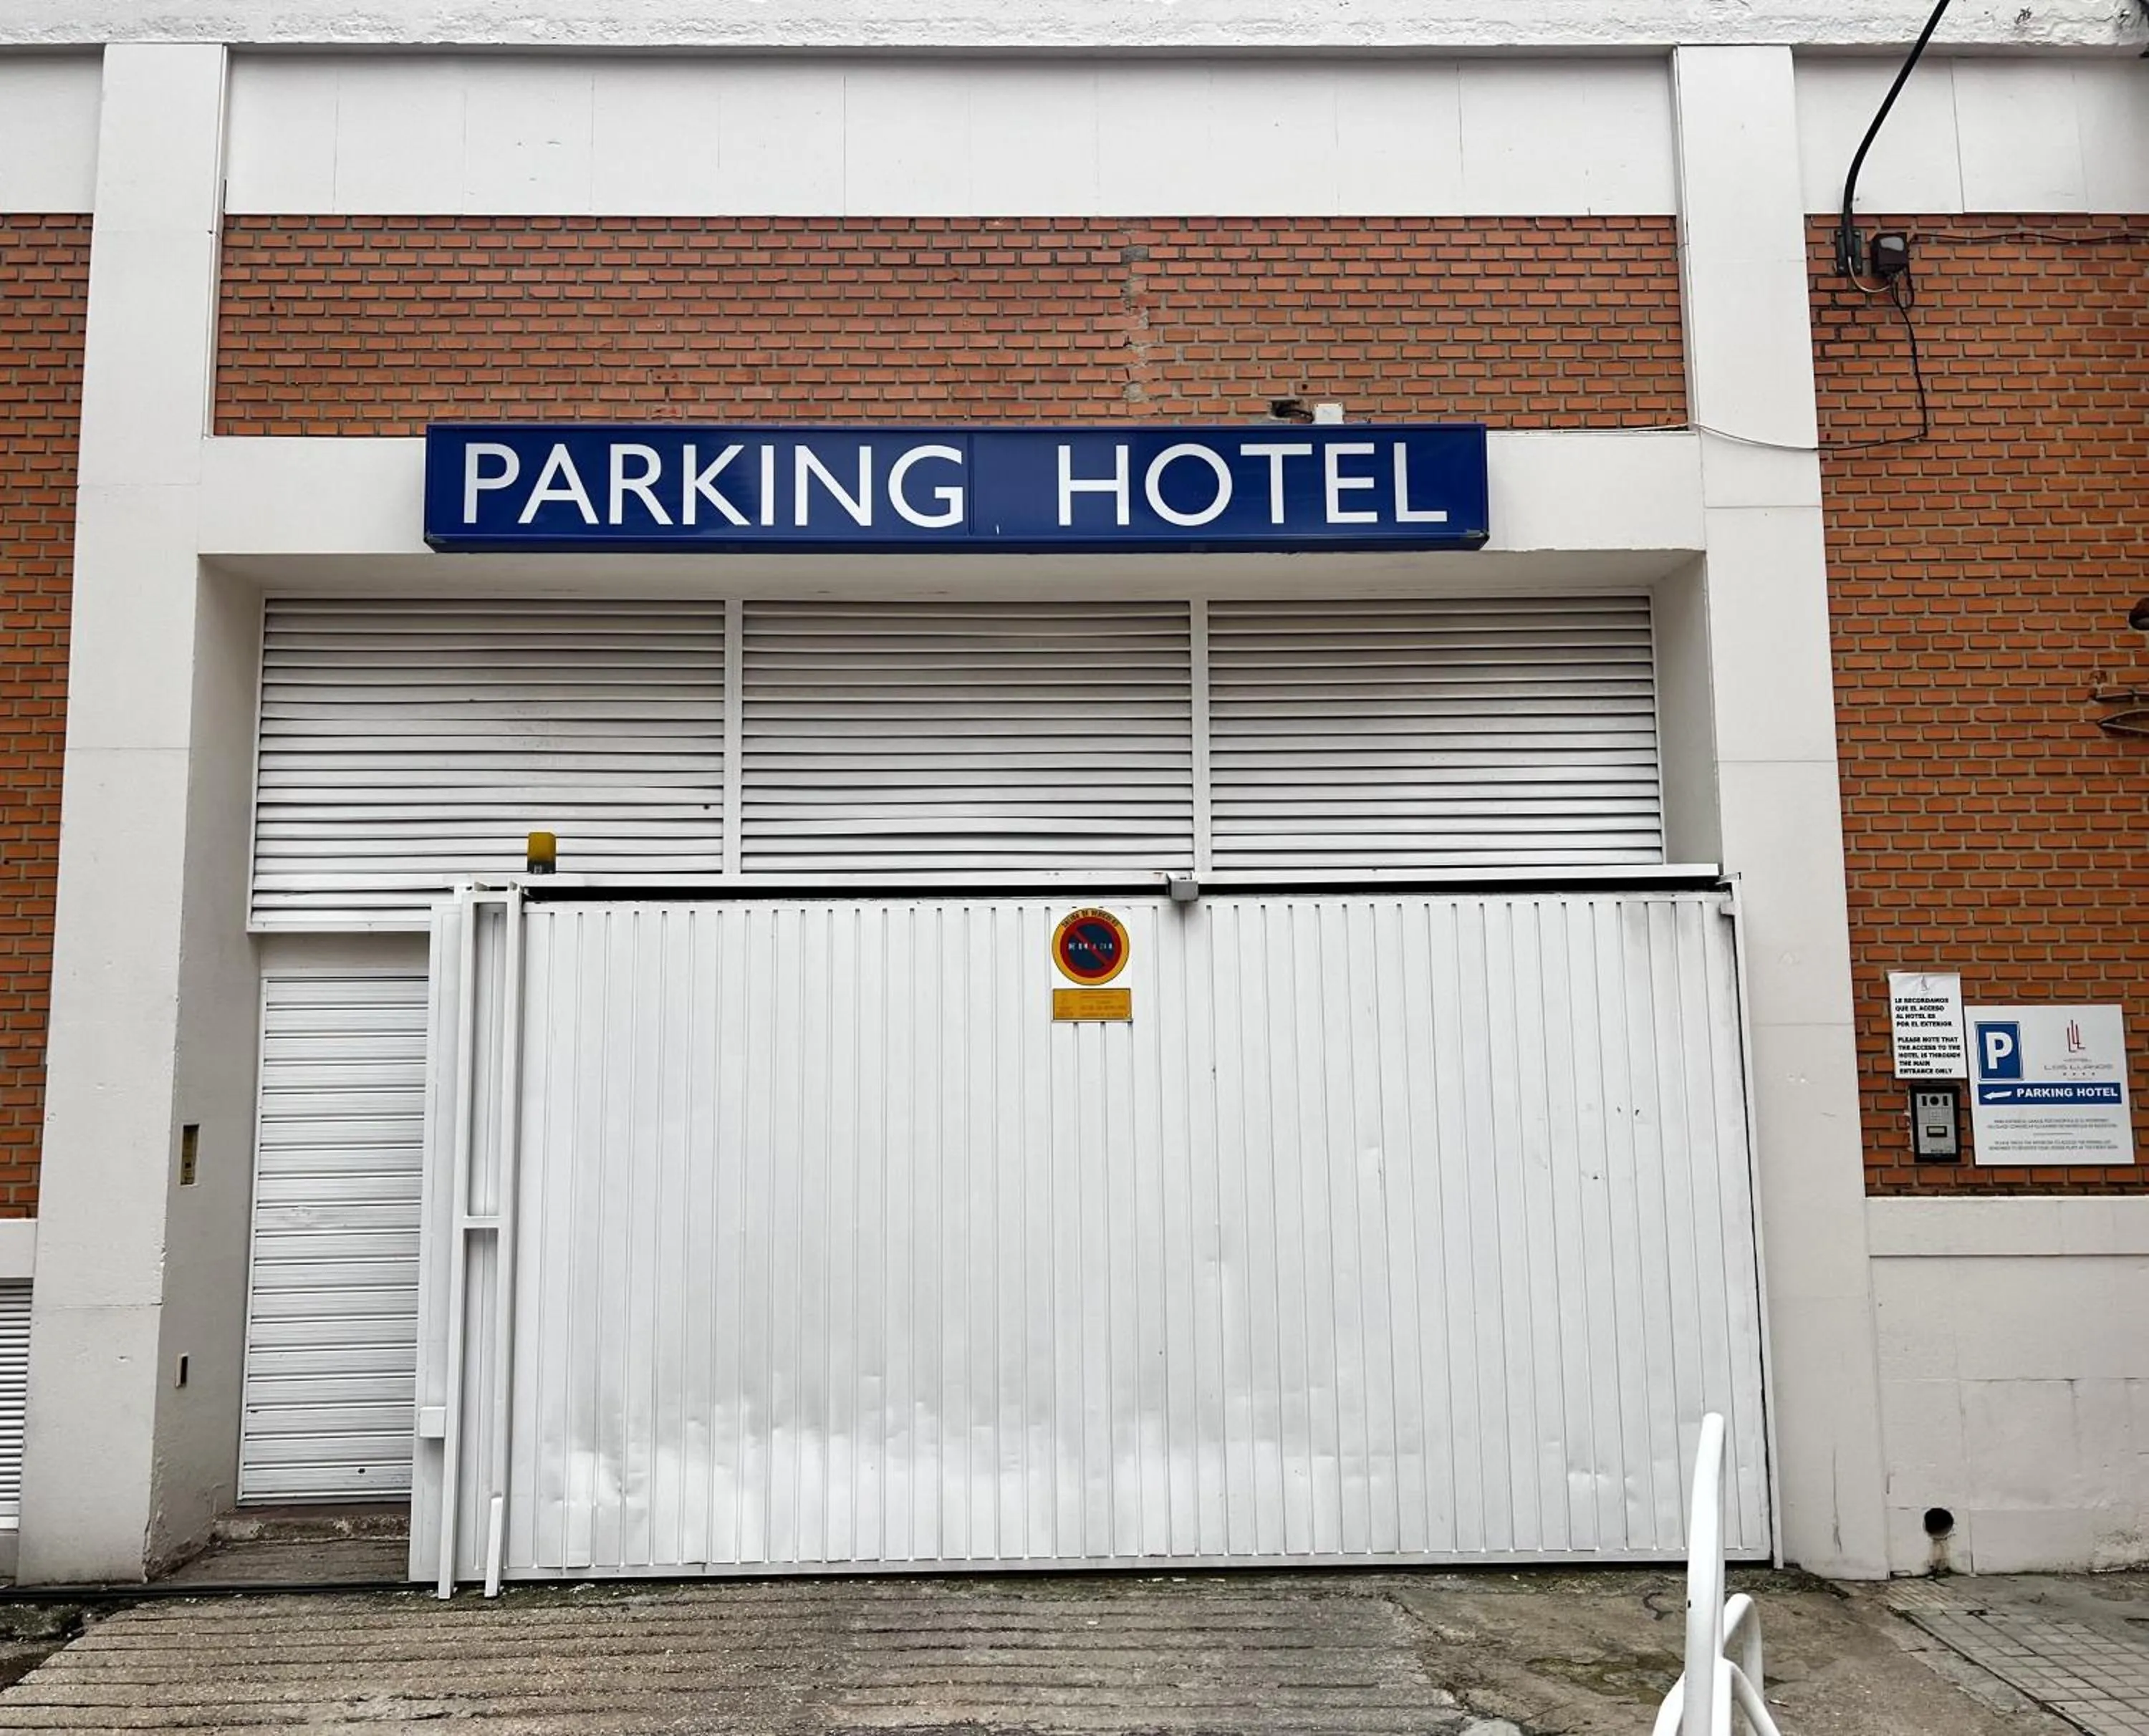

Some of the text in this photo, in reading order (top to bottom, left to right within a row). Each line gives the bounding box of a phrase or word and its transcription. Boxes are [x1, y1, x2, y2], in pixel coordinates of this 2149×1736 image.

[463, 443, 1448, 528] PARKING HOTEL
[1985, 1031, 2014, 1069] P
[2016, 1087, 2118, 1099] PARKING HOTEL
